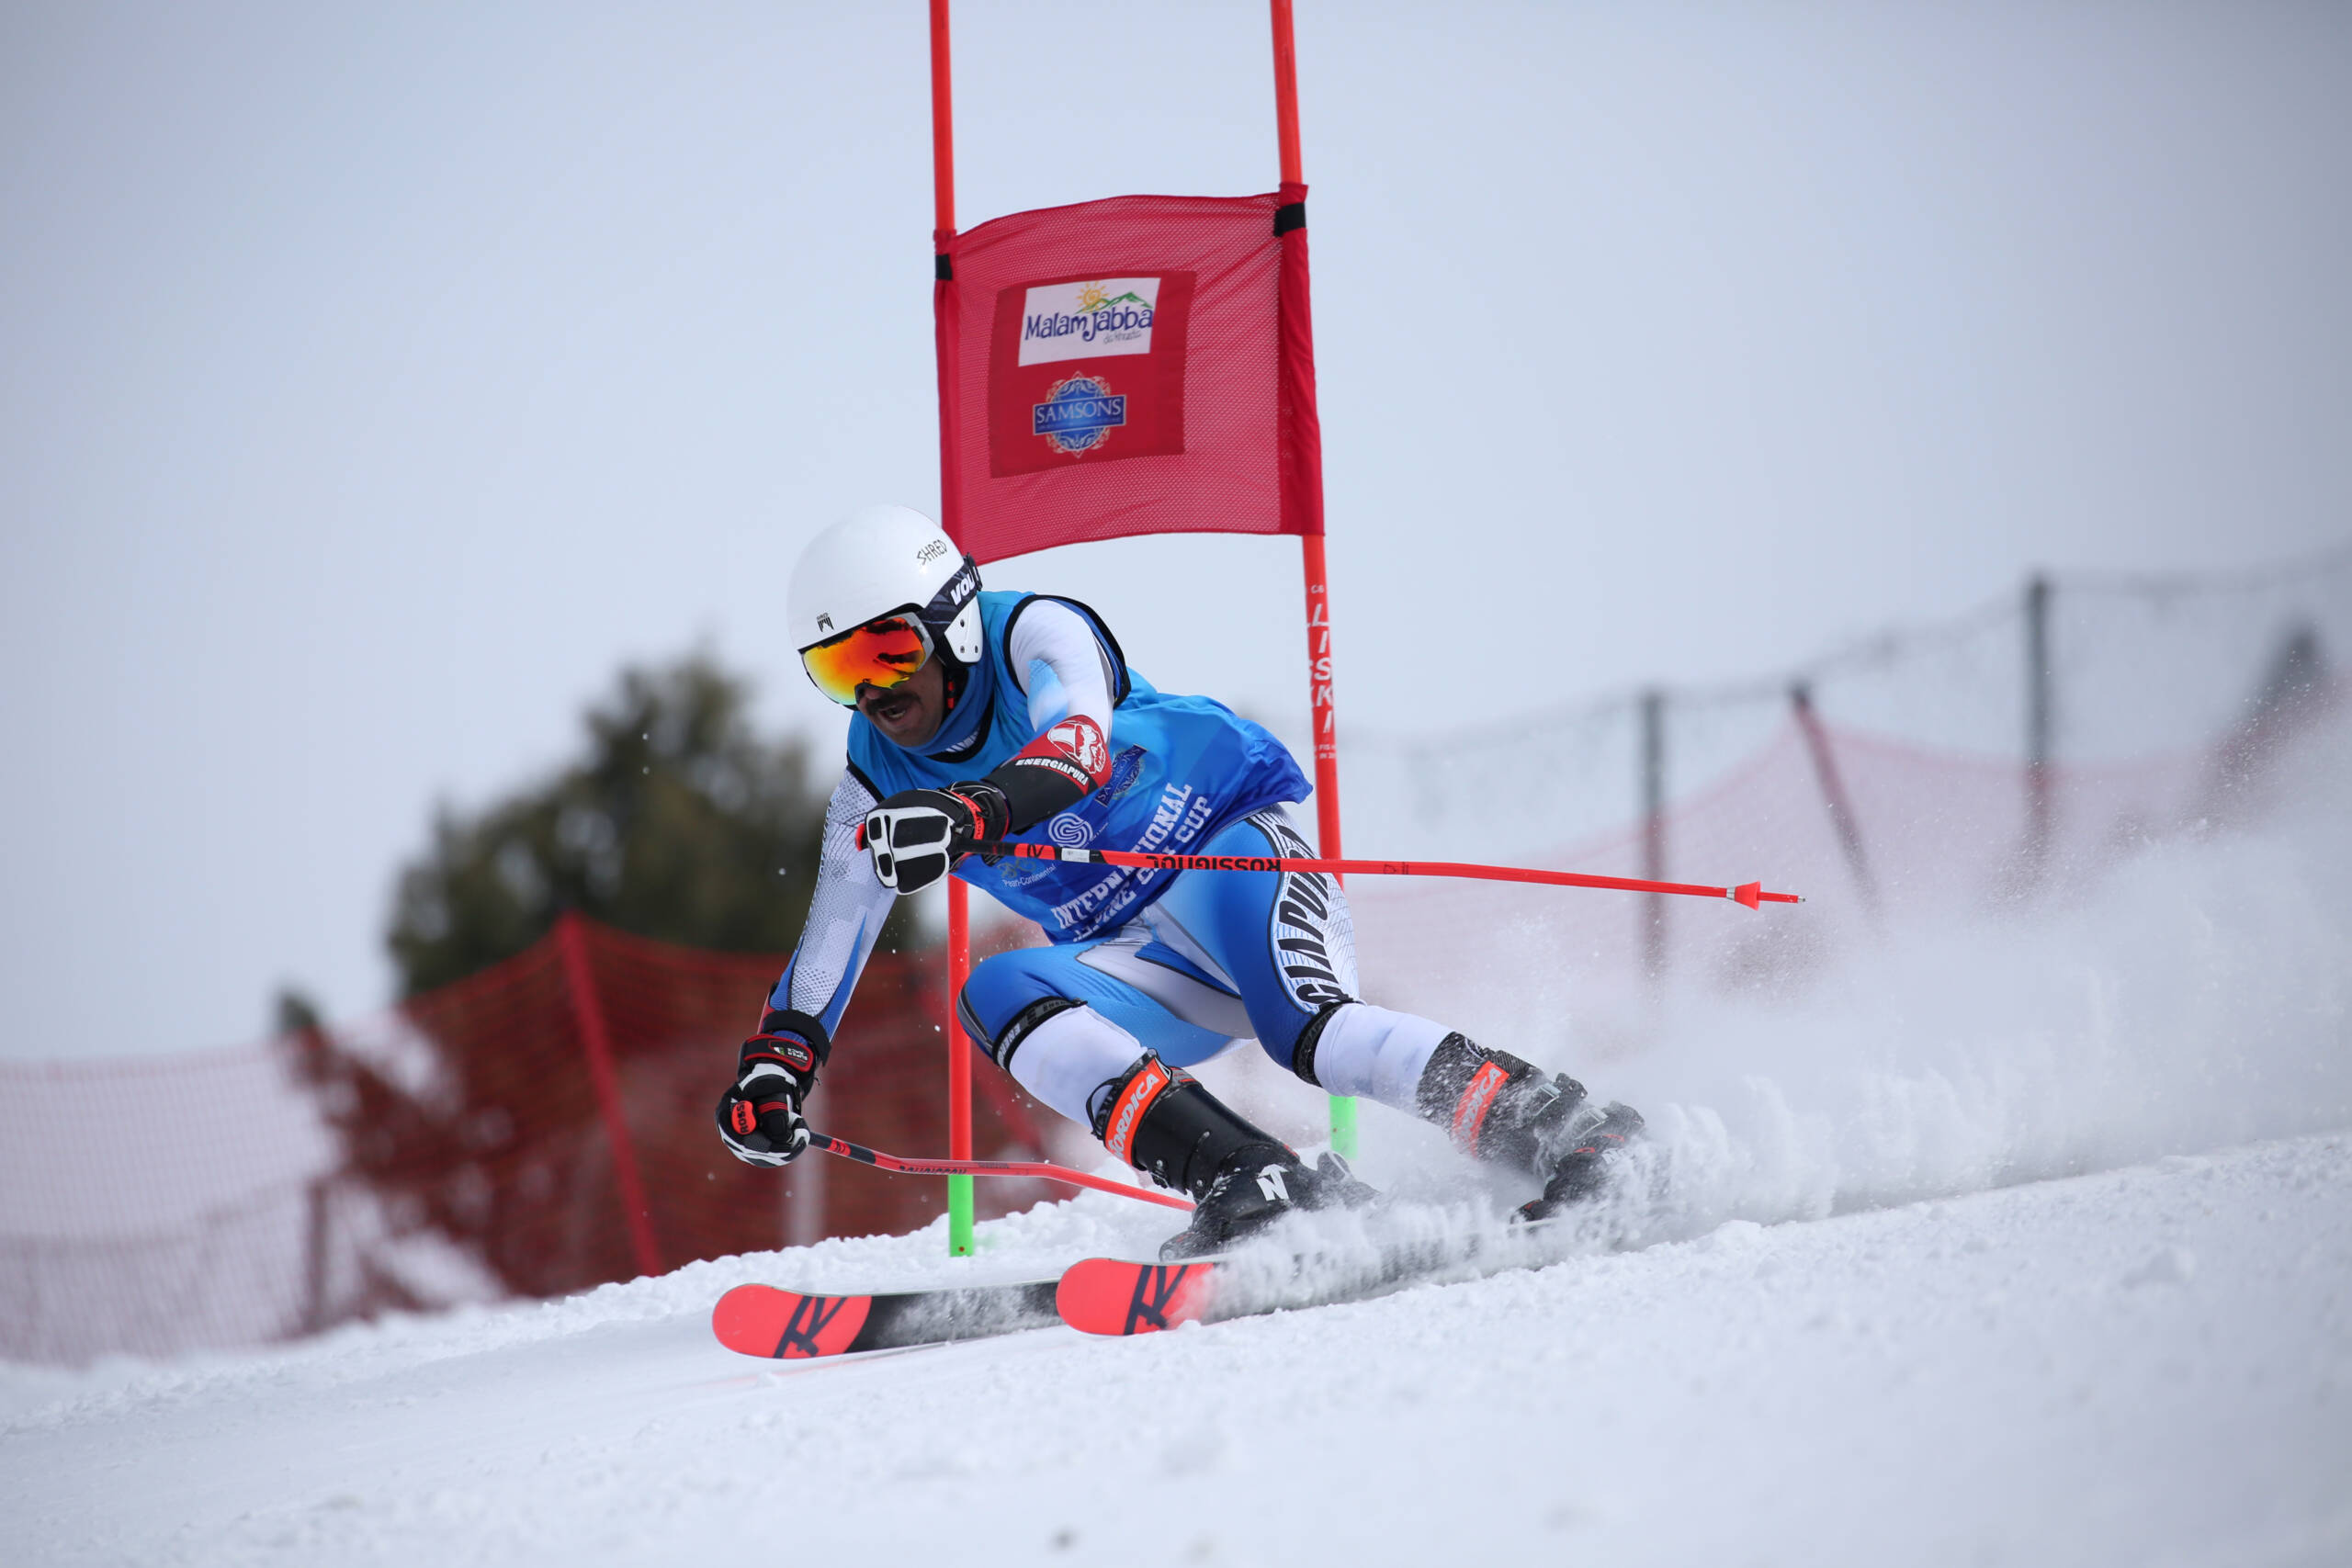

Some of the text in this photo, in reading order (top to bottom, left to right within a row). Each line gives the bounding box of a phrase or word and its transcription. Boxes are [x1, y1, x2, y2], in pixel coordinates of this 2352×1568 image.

[1024, 312, 1087, 341] Malam
[1035, 398, 1121, 423] SAMSONS
[917, 539, 947, 565] SHRED
[1311, 603, 1334, 734] LISKI
[1015, 758, 1090, 785] ENERGIAPURA
[1174, 795, 1212, 843] CUP
